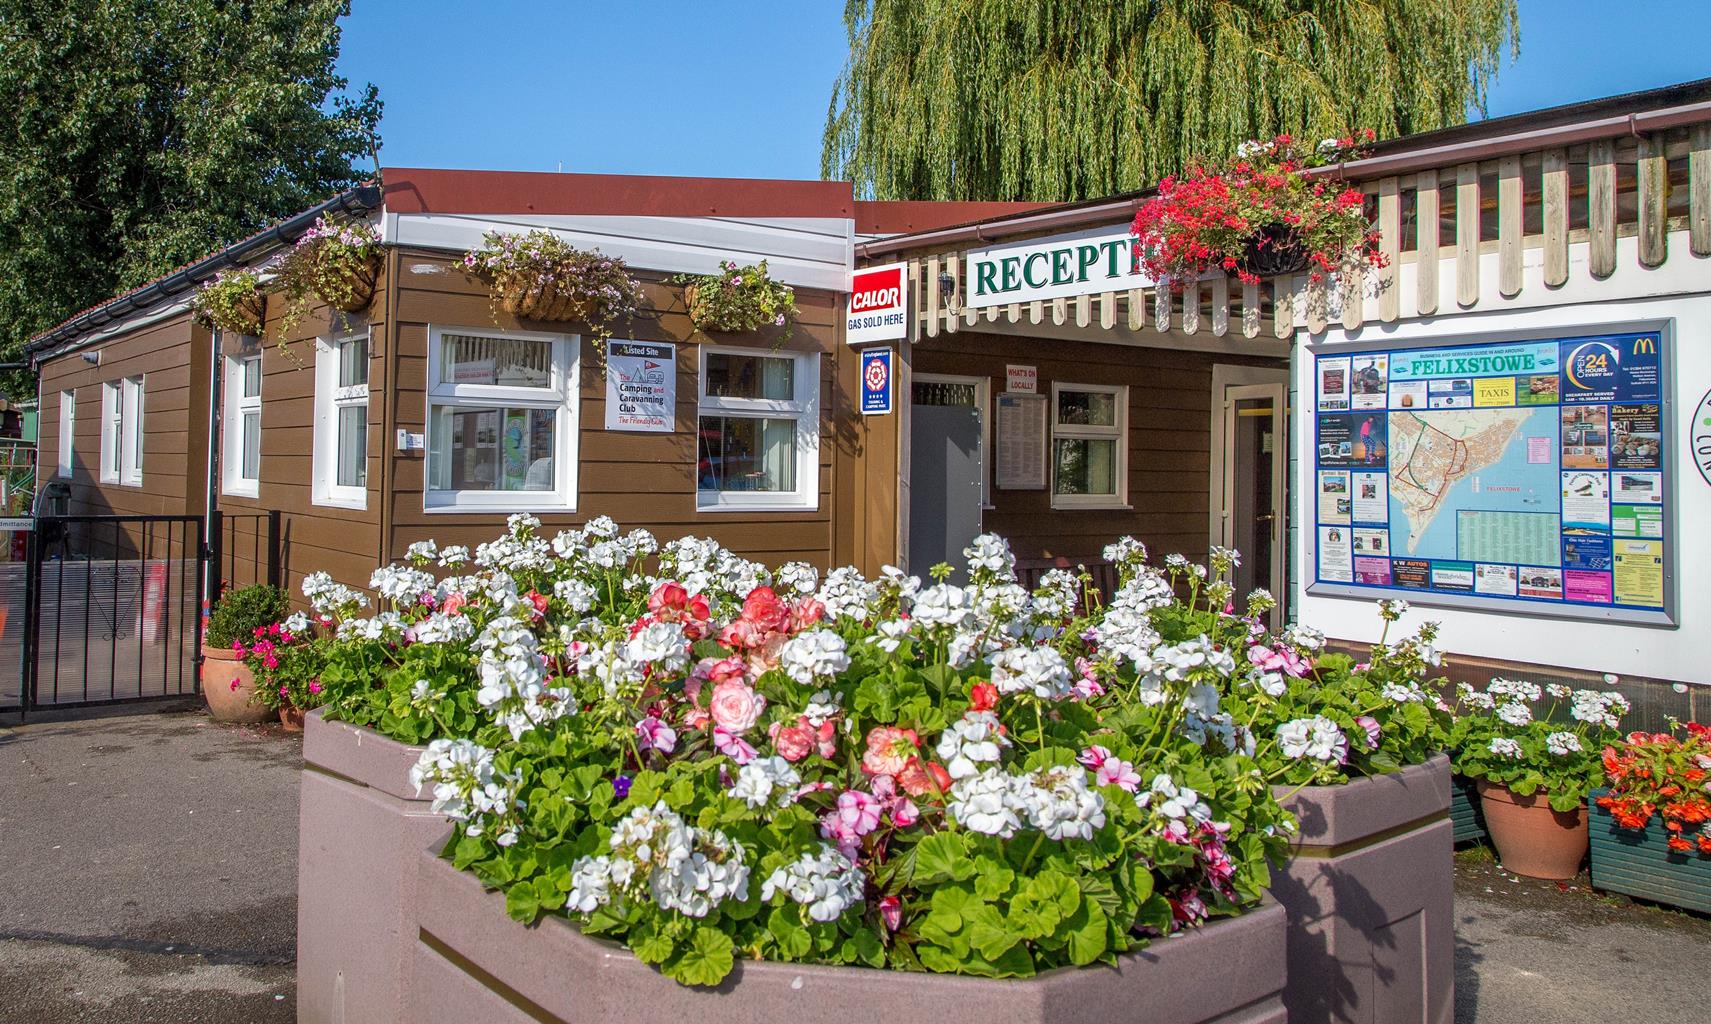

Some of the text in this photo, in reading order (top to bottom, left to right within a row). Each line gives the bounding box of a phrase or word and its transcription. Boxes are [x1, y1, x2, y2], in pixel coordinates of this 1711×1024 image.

[975, 237, 1154, 297] RECEPTI
[852, 287, 900, 310] CALOR
[848, 313, 904, 330] GAS SOLD HERE
[646, 347, 659, 356] Site
[1410, 353, 1536, 376] FELIXSTOWE
[1576, 355, 1585, 378] OPEN
[1585, 353, 1607, 368] 24
[619, 373, 631, 381] The
[1007, 368, 1027, 377] WHAT'S
[619, 383, 652, 395] Camping
[1479, 388, 1510, 398] TAXIS
[619, 393, 664, 406] Caravanning
[619, 404, 636, 413] Club
[618, 416, 629, 425] The
[629, 416, 651, 428] Friendly
